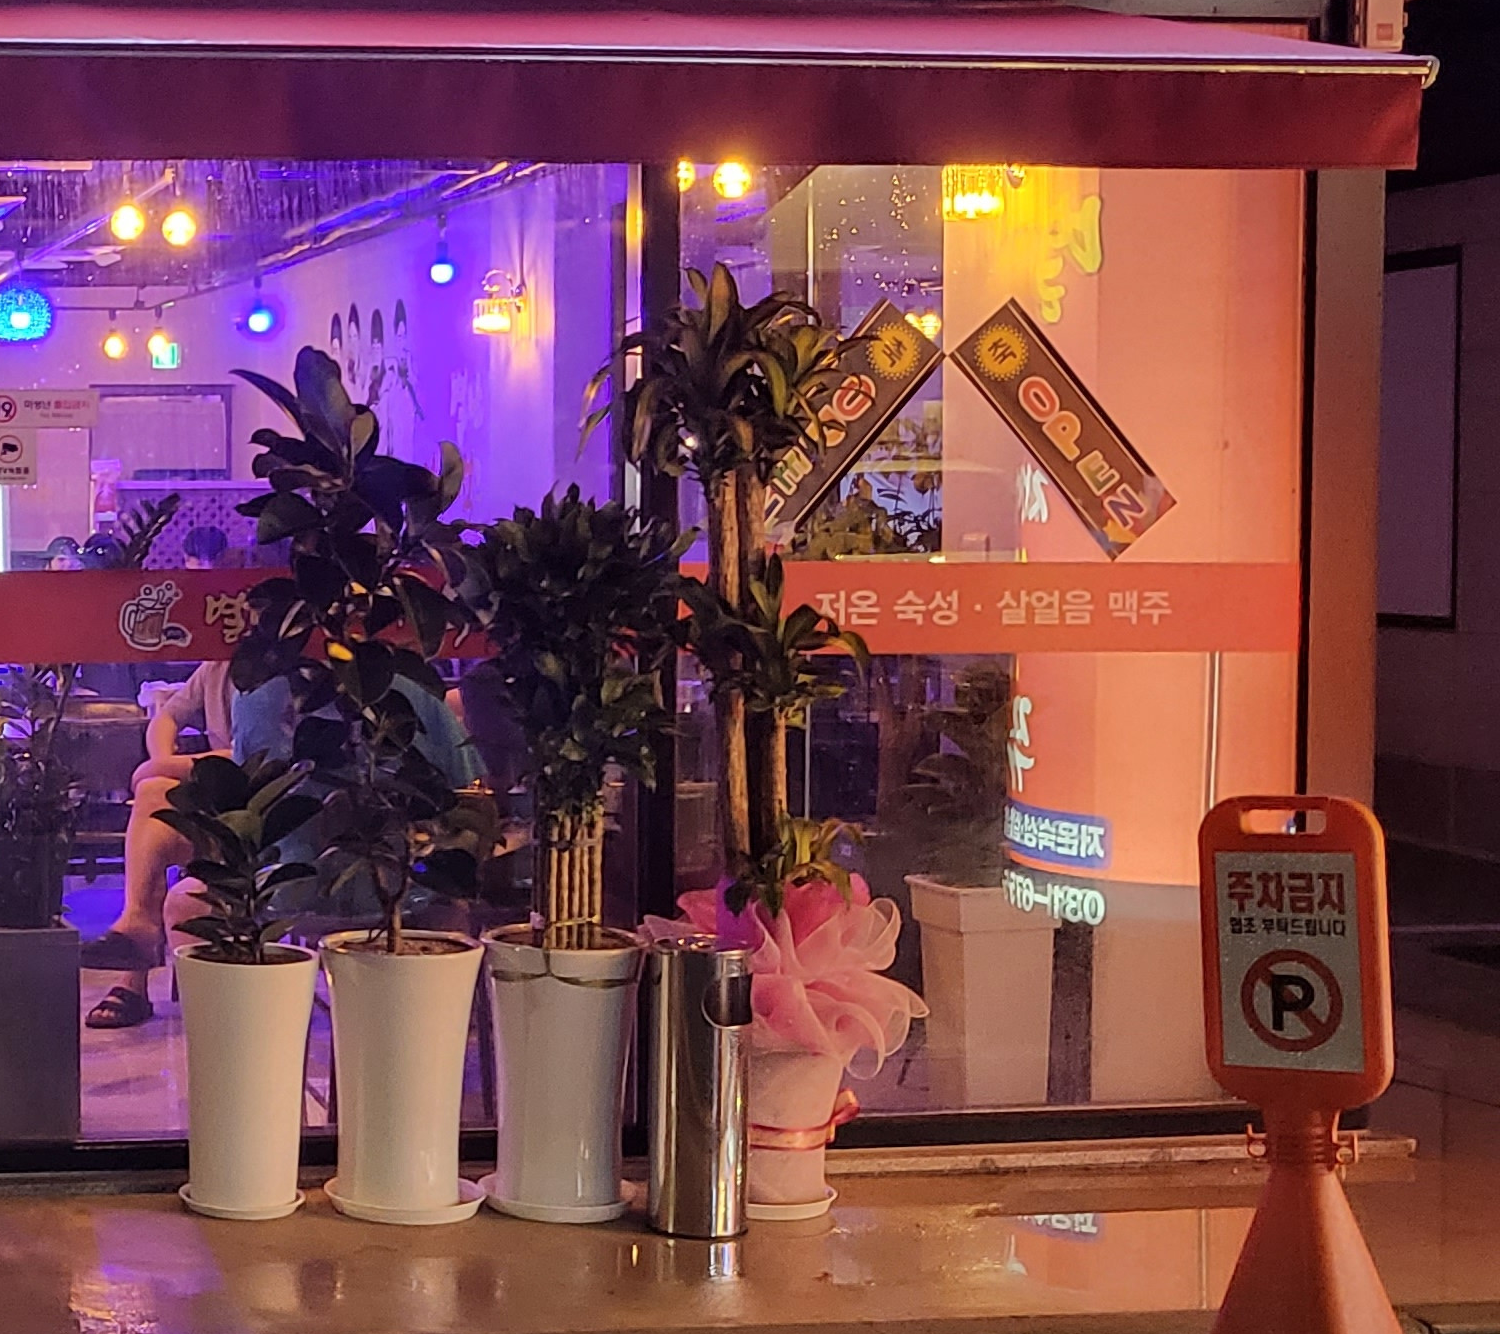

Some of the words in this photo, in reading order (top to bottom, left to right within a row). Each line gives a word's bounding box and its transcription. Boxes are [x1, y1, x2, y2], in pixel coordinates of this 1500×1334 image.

[1018, 375, 1147, 530] OPEN
[814, 589, 881, 626] 저온
[893, 589, 960, 626] 숙성
[995, 589, 1095, 627] 살얼음
[1108, 590, 1173, 626] 맥주
[1227, 871, 1346, 916] 주차금지
